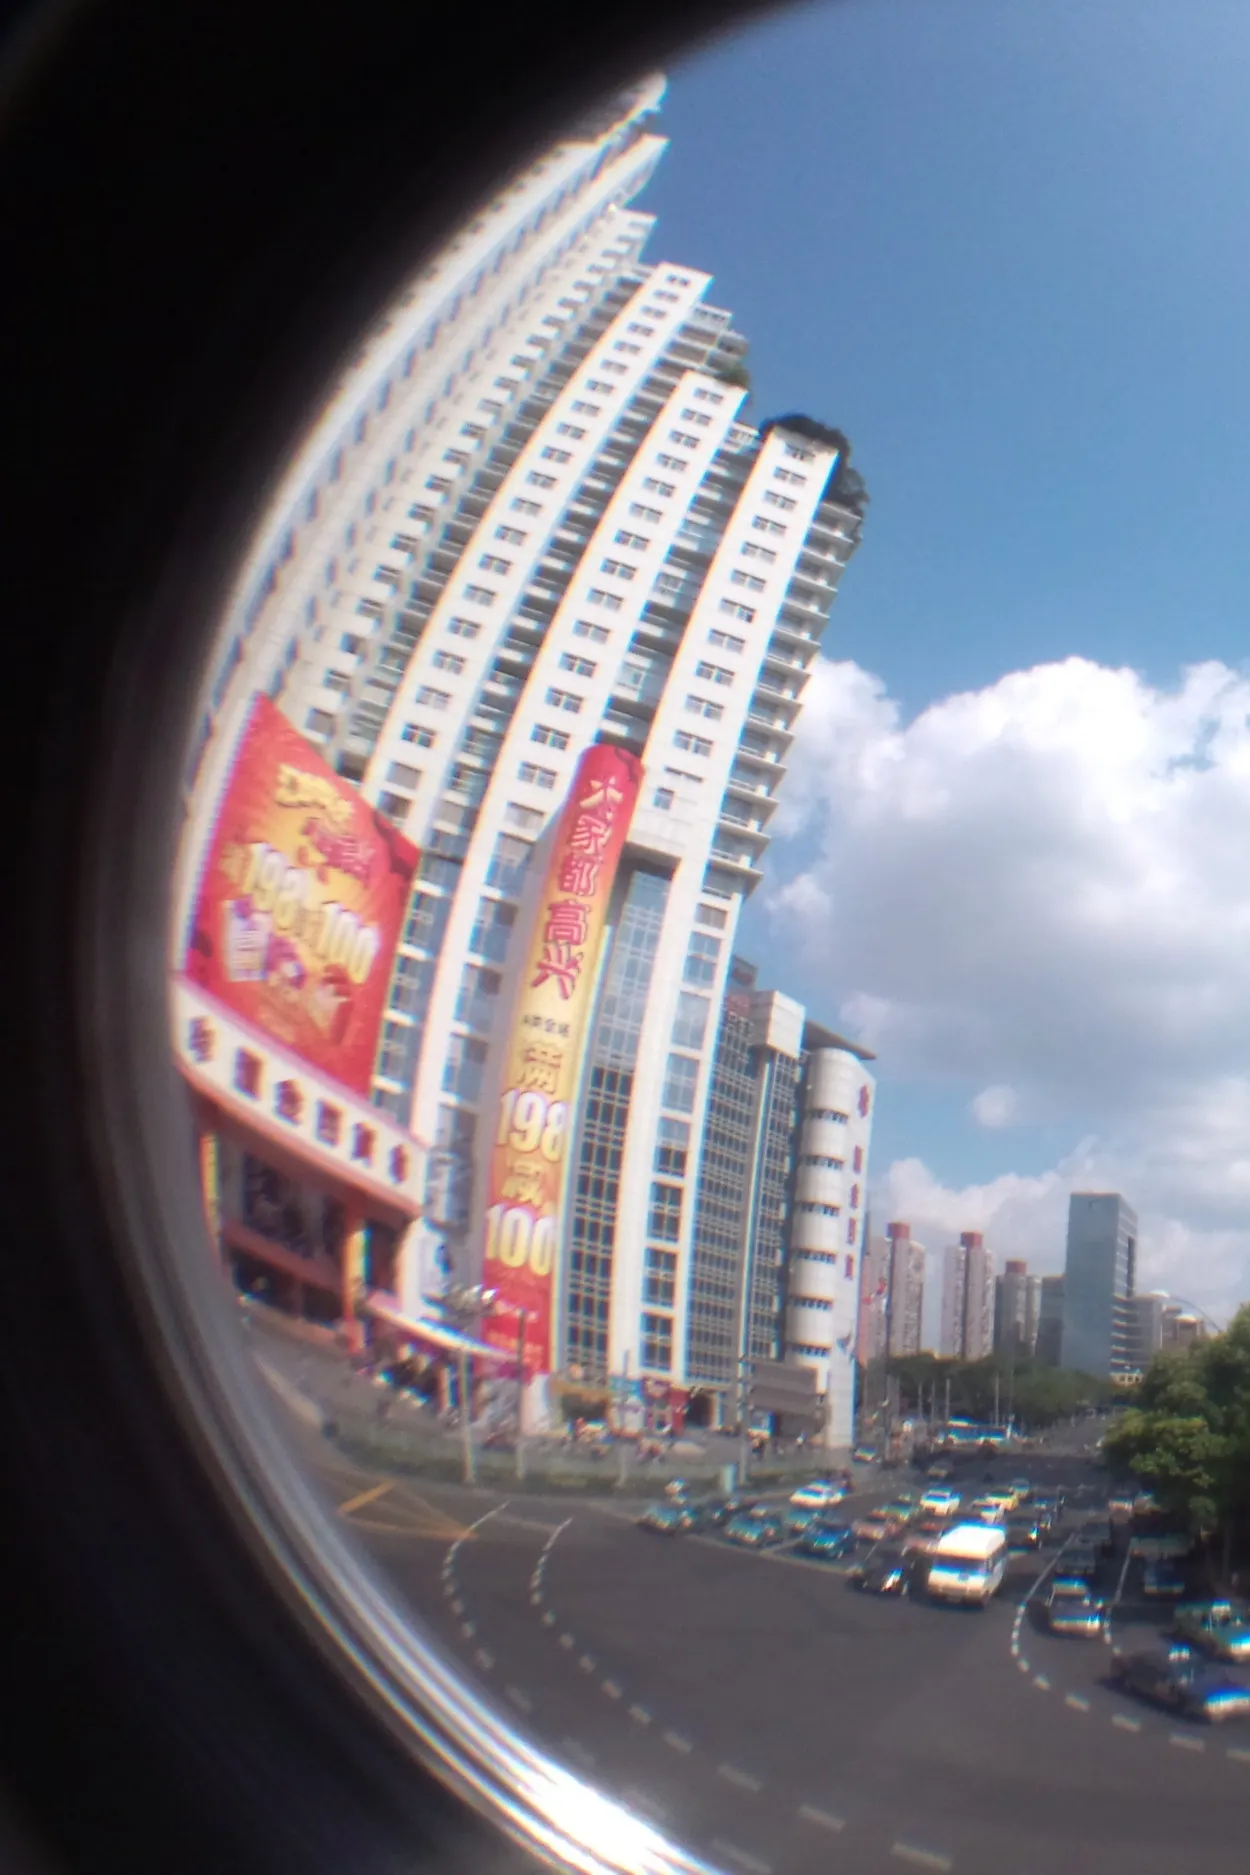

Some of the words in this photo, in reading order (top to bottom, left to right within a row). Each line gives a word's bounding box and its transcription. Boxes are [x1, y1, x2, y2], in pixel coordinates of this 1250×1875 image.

[531, 774, 624, 1001] 大家都高兴
[495, 1088, 570, 1161] 198
[484, 1203, 557, 1277] 100
